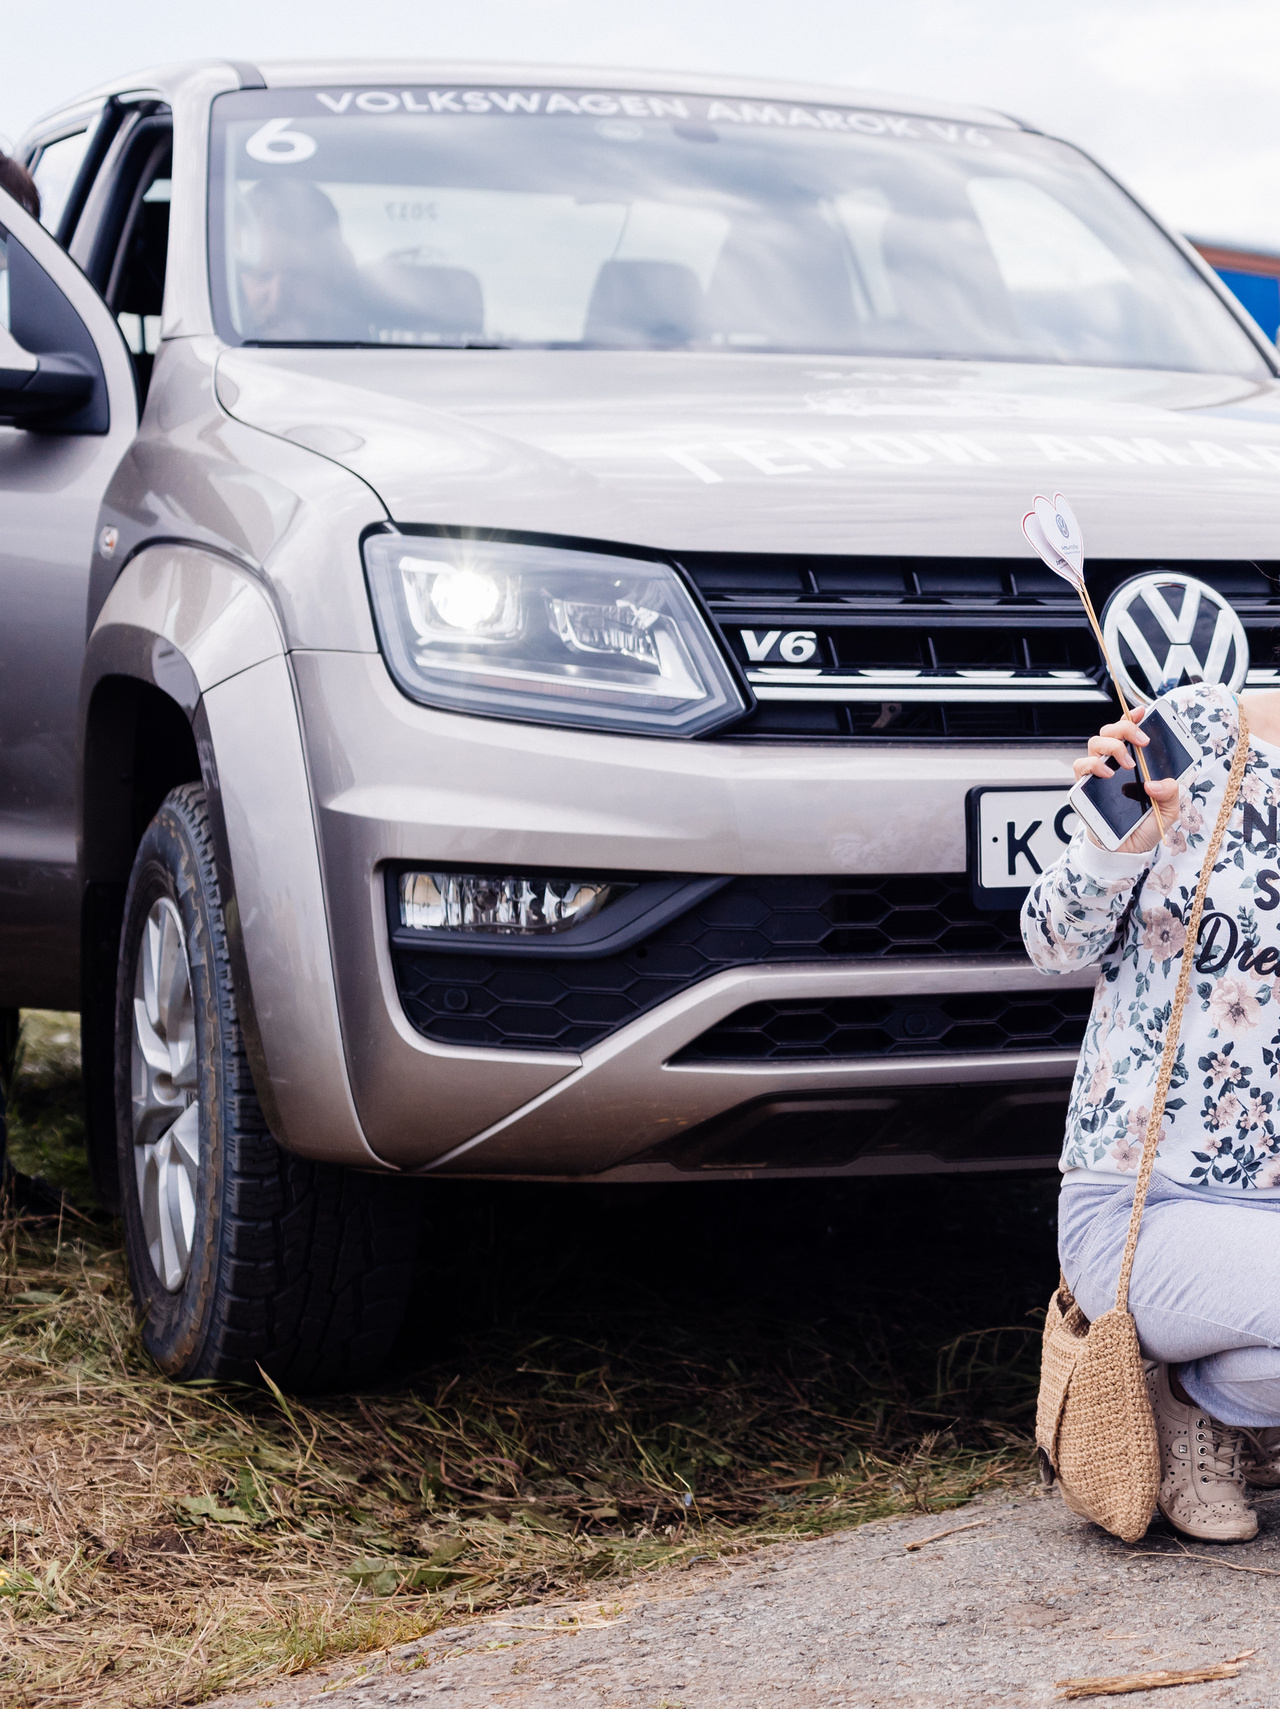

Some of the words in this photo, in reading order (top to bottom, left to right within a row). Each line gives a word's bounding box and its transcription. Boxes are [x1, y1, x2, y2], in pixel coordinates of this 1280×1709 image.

[244, 117, 317, 164] 6
[316, 90, 690, 119] VOLKSWAGEN
[707, 101, 921, 139] AMAROK
[926, 121, 991, 148] V6
[740, 629, 817, 663] V6
